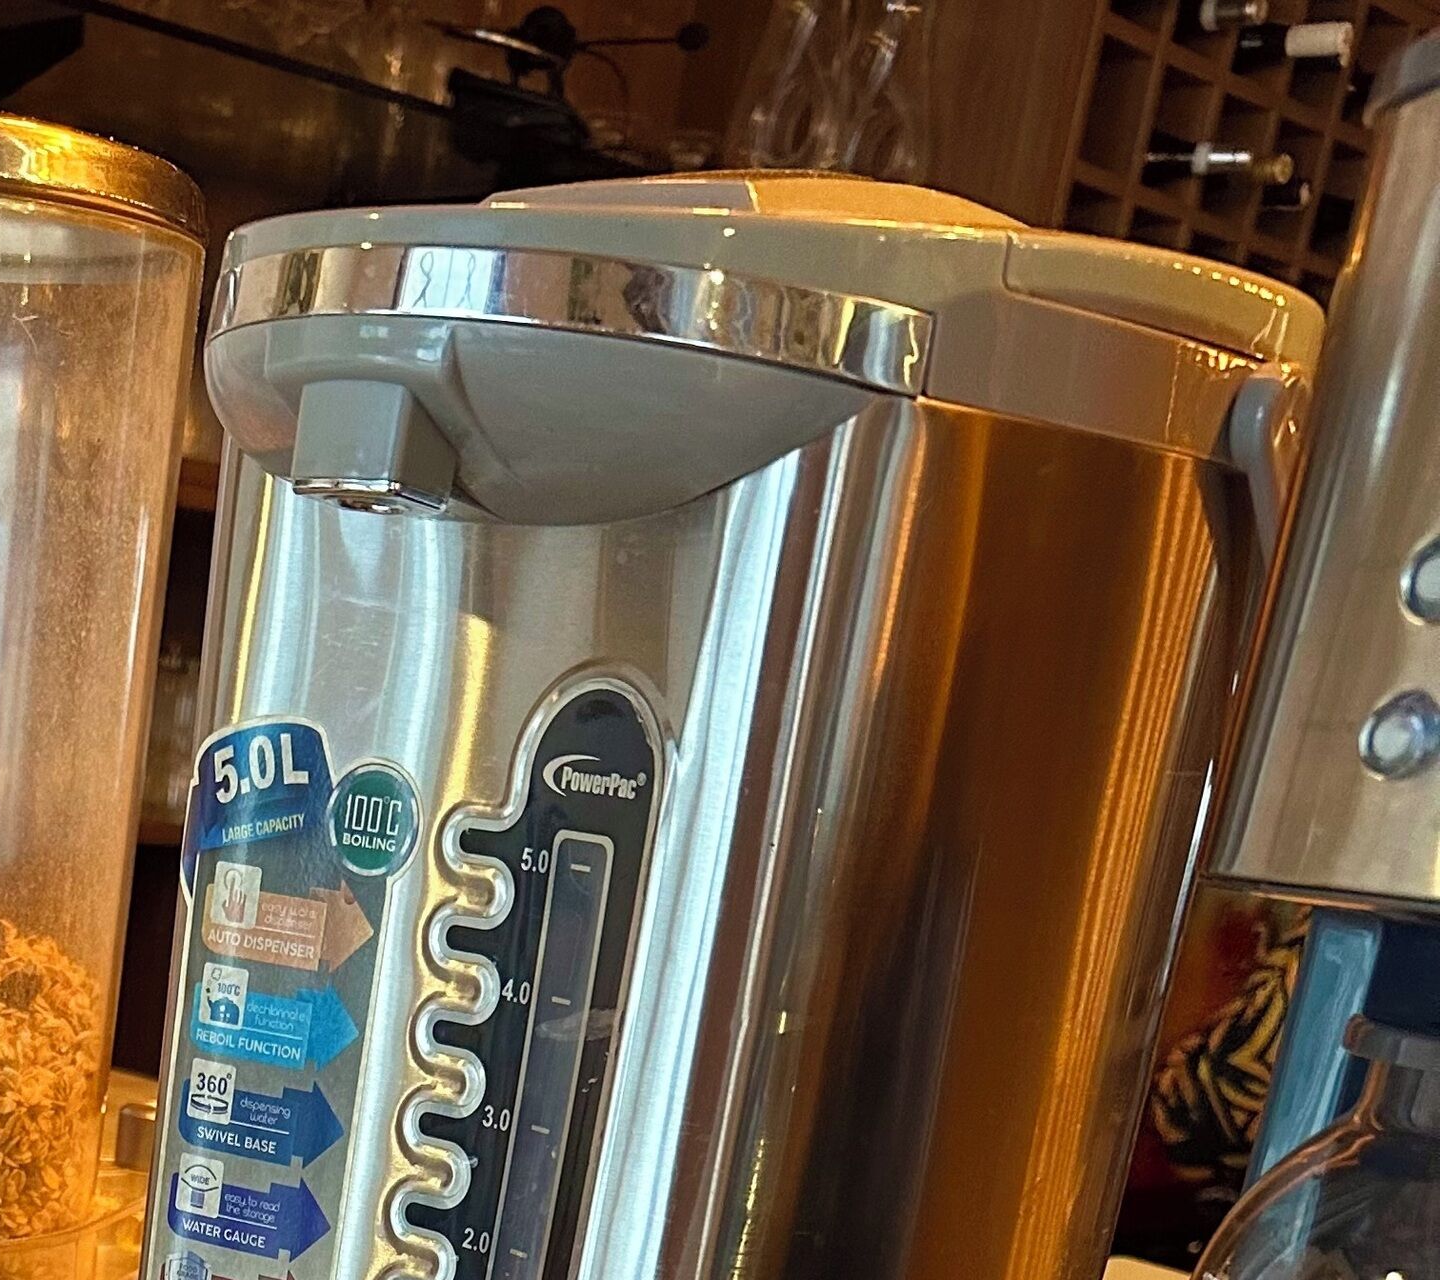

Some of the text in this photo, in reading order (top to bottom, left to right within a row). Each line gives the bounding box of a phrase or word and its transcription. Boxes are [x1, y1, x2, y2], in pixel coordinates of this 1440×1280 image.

[214, 732, 309, 804] 5.0L
[222, 813, 305, 844] LARGE CAPACITY
[342, 832, 396, 852] BOILING
[520, 846, 549, 874] 5.0
[207, 928, 315, 960] AUTO DISPENSER
[501, 977, 531, 1005] 4.0
[196, 1028, 301, 1061] REBOIL FUNCTION
[240, 1097, 291, 1119] dispensing
[481, 1105, 511, 1132] 3.0
[196, 1126, 277, 1154] SWIVEL BASE
[182, 1218, 266, 1248] WATER GAUGE
[461, 1227, 490, 1254] 2.0
